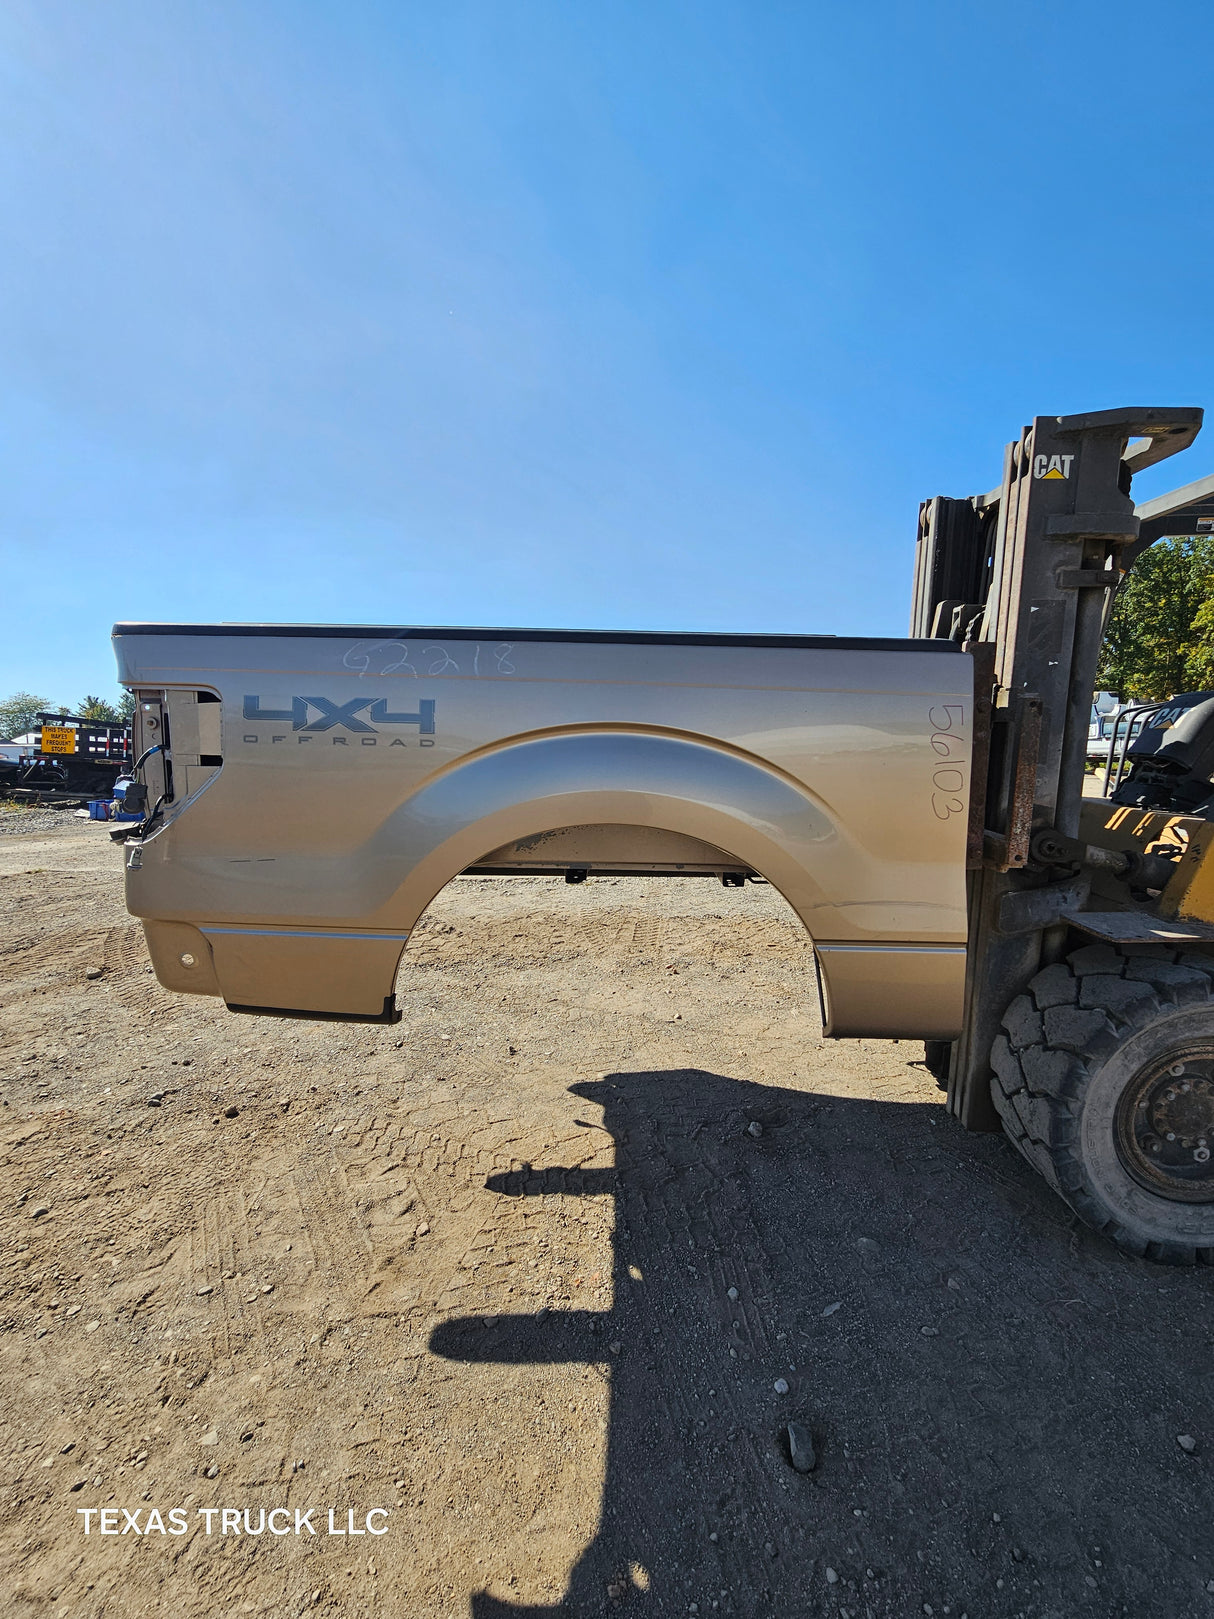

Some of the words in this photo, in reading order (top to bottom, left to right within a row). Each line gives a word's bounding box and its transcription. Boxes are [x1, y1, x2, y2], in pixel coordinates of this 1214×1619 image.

[1034, 455, 1074, 479] CAT
[243, 695, 435, 734] 4X4
[929, 705, 966, 820] 56103
